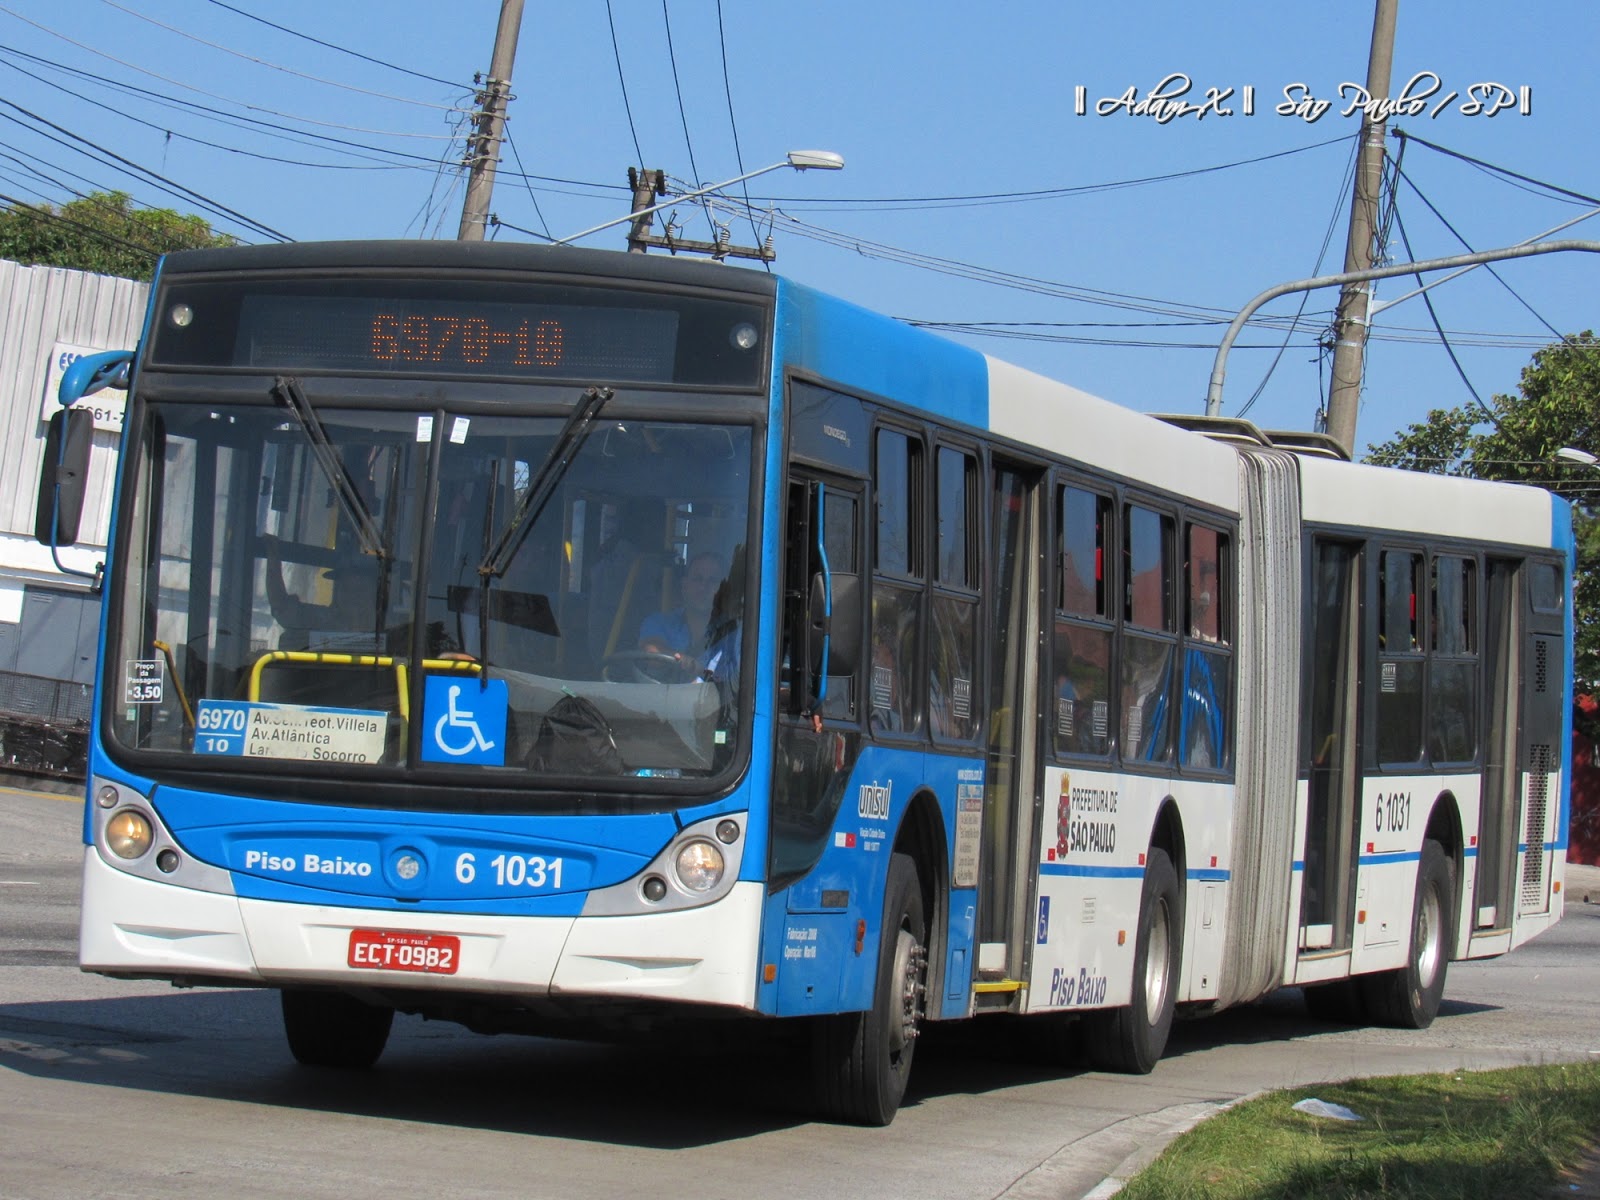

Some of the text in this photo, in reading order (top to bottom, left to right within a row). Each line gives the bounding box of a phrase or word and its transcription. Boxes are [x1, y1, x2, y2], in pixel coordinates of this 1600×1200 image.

[373, 315, 562, 366] 6970-10
[133, 686, 161, 700] 3,50
[199, 707, 246, 731] 6970
[206, 738, 229, 752] 10
[312, 746, 367, 763] Socorro
[1072, 787, 1118, 814] PREFEITURA DE
[1375, 791, 1411, 832] 6 1031
[1070, 814, 1116, 853] SÃO PAULO
[245, 850, 372, 877] Piso Baixo
[455, 852, 563, 889] 6 1031
[1050, 967, 1107, 1006] Piso Baixo
